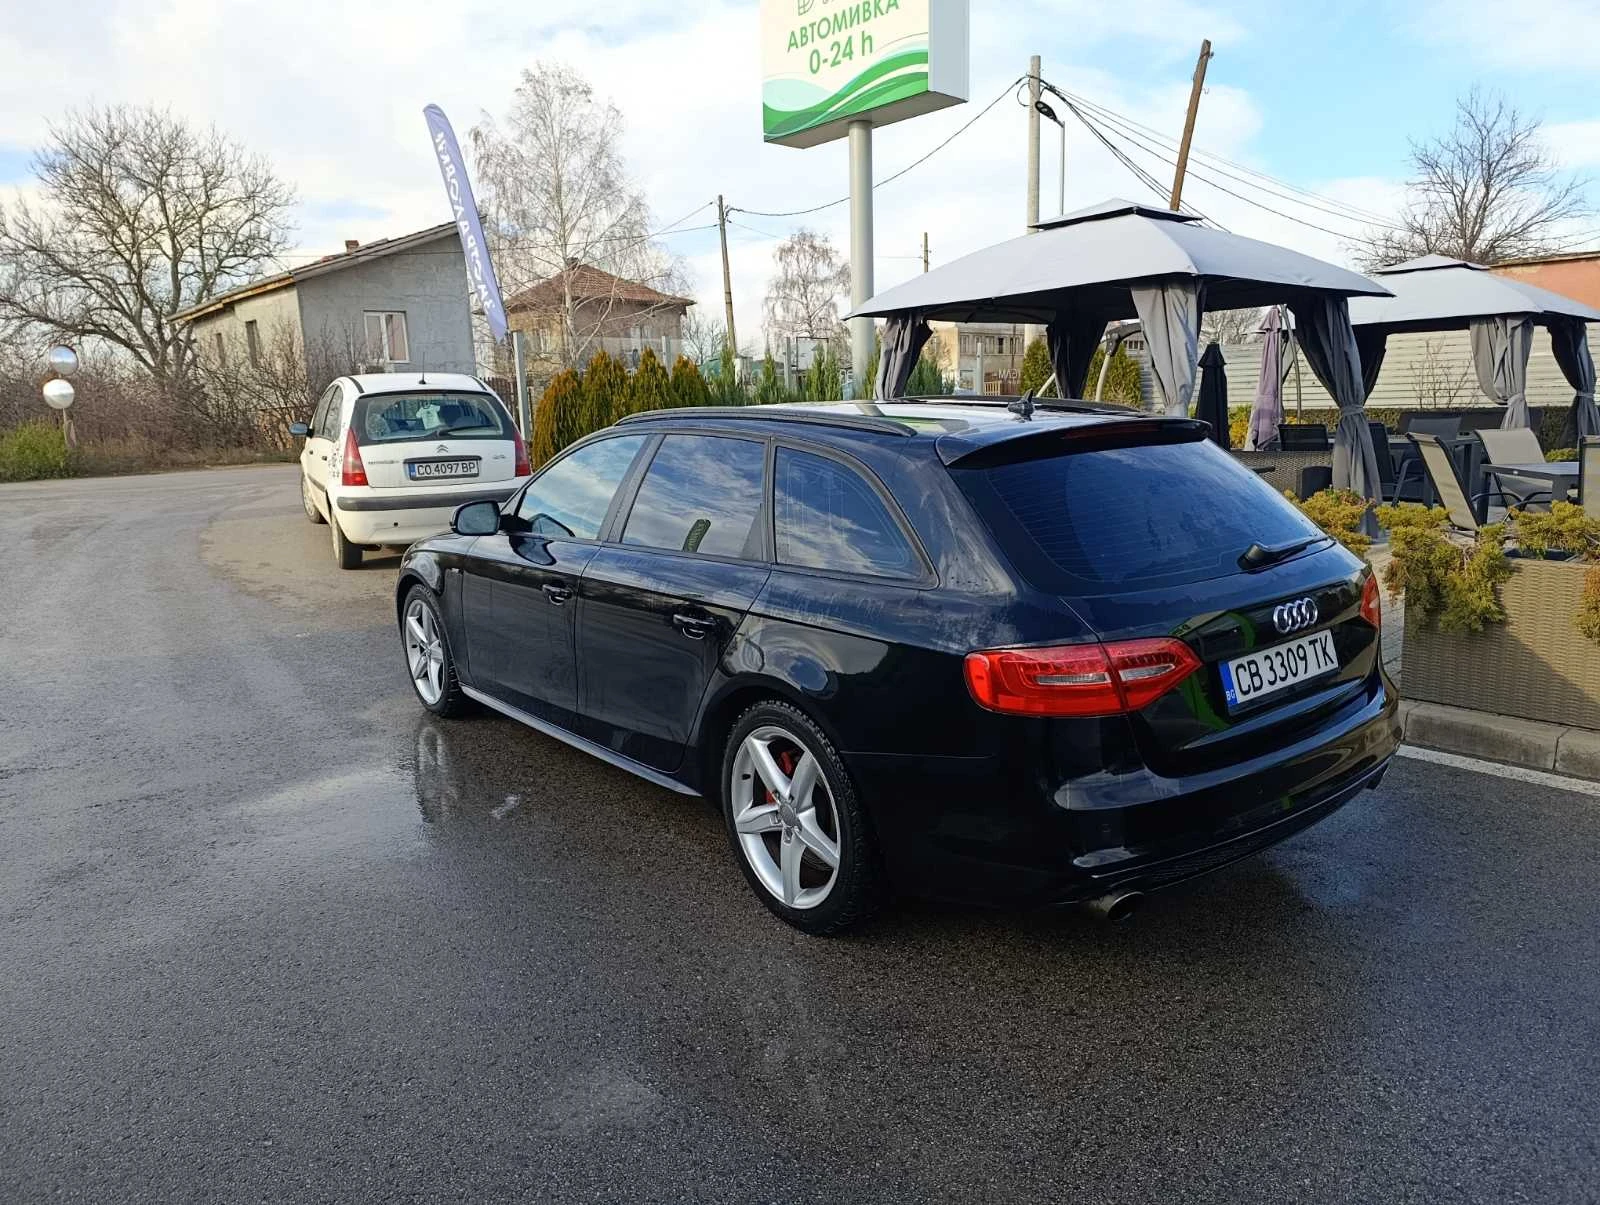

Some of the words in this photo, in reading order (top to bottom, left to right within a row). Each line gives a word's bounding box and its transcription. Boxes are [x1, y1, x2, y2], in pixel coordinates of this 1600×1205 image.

[809, 35, 854, 75] 0-24
[861, 30, 874, 57] h
[434, 463, 459, 475] 4097
[461, 462, 476, 473] BP
[1235, 659, 1264, 696] CB
[1264, 643, 1309, 686] 3309
[1308, 634, 1334, 670] TK
